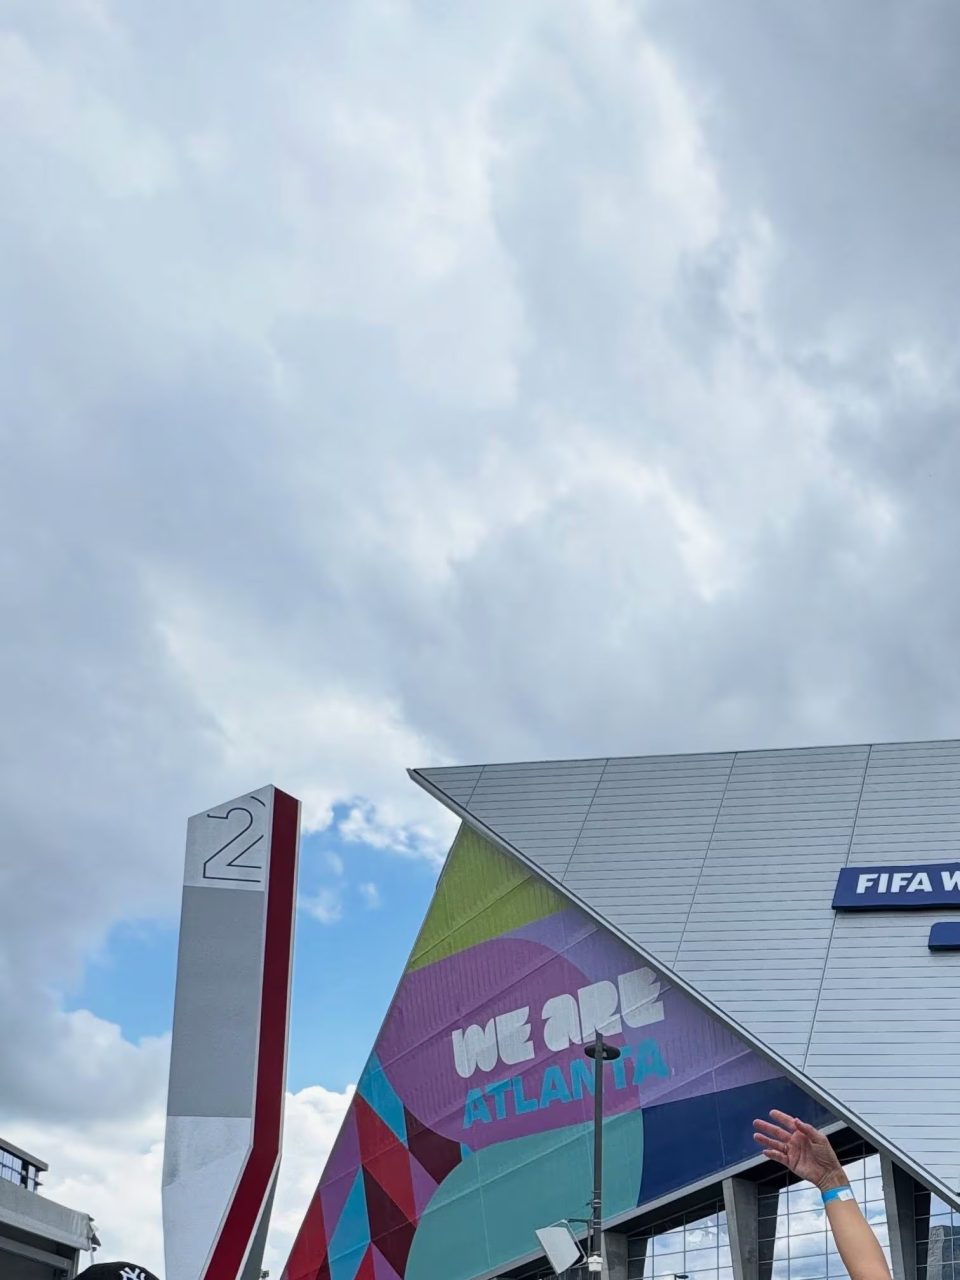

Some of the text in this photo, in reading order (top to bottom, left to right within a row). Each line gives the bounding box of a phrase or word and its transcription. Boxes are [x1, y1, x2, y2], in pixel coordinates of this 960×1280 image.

[203, 796, 266, 883] 2
[856, 872, 932, 894] FIFA
[452, 966, 665, 1078] WE ARE
[462, 1037, 670, 1129] ATLANTA
